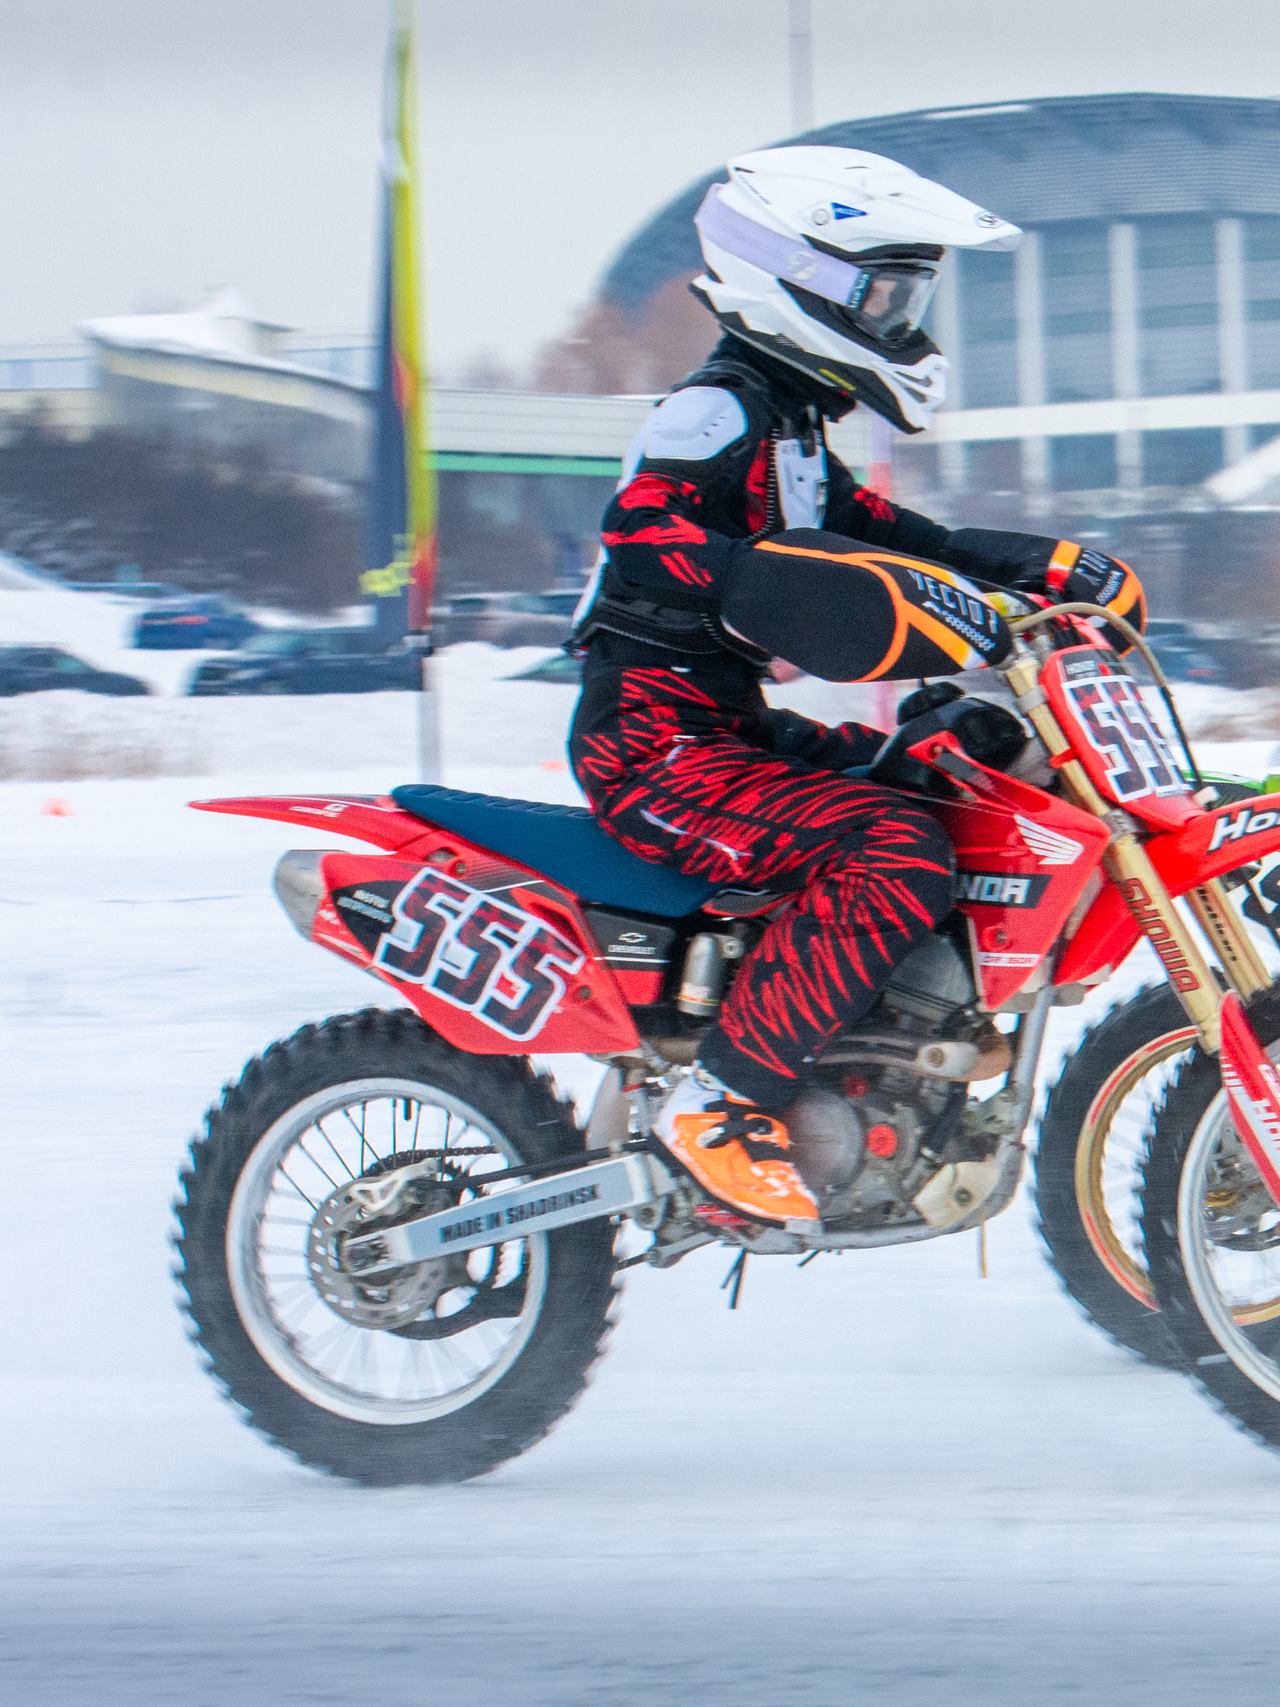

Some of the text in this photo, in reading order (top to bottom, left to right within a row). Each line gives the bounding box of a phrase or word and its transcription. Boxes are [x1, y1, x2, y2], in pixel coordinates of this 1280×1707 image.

[370, 866, 587, 1042] 555
[1125, 877, 1200, 993] SHOWA
[440, 1216, 482, 1243] MADE
[486, 1211, 501, 1230] IN
